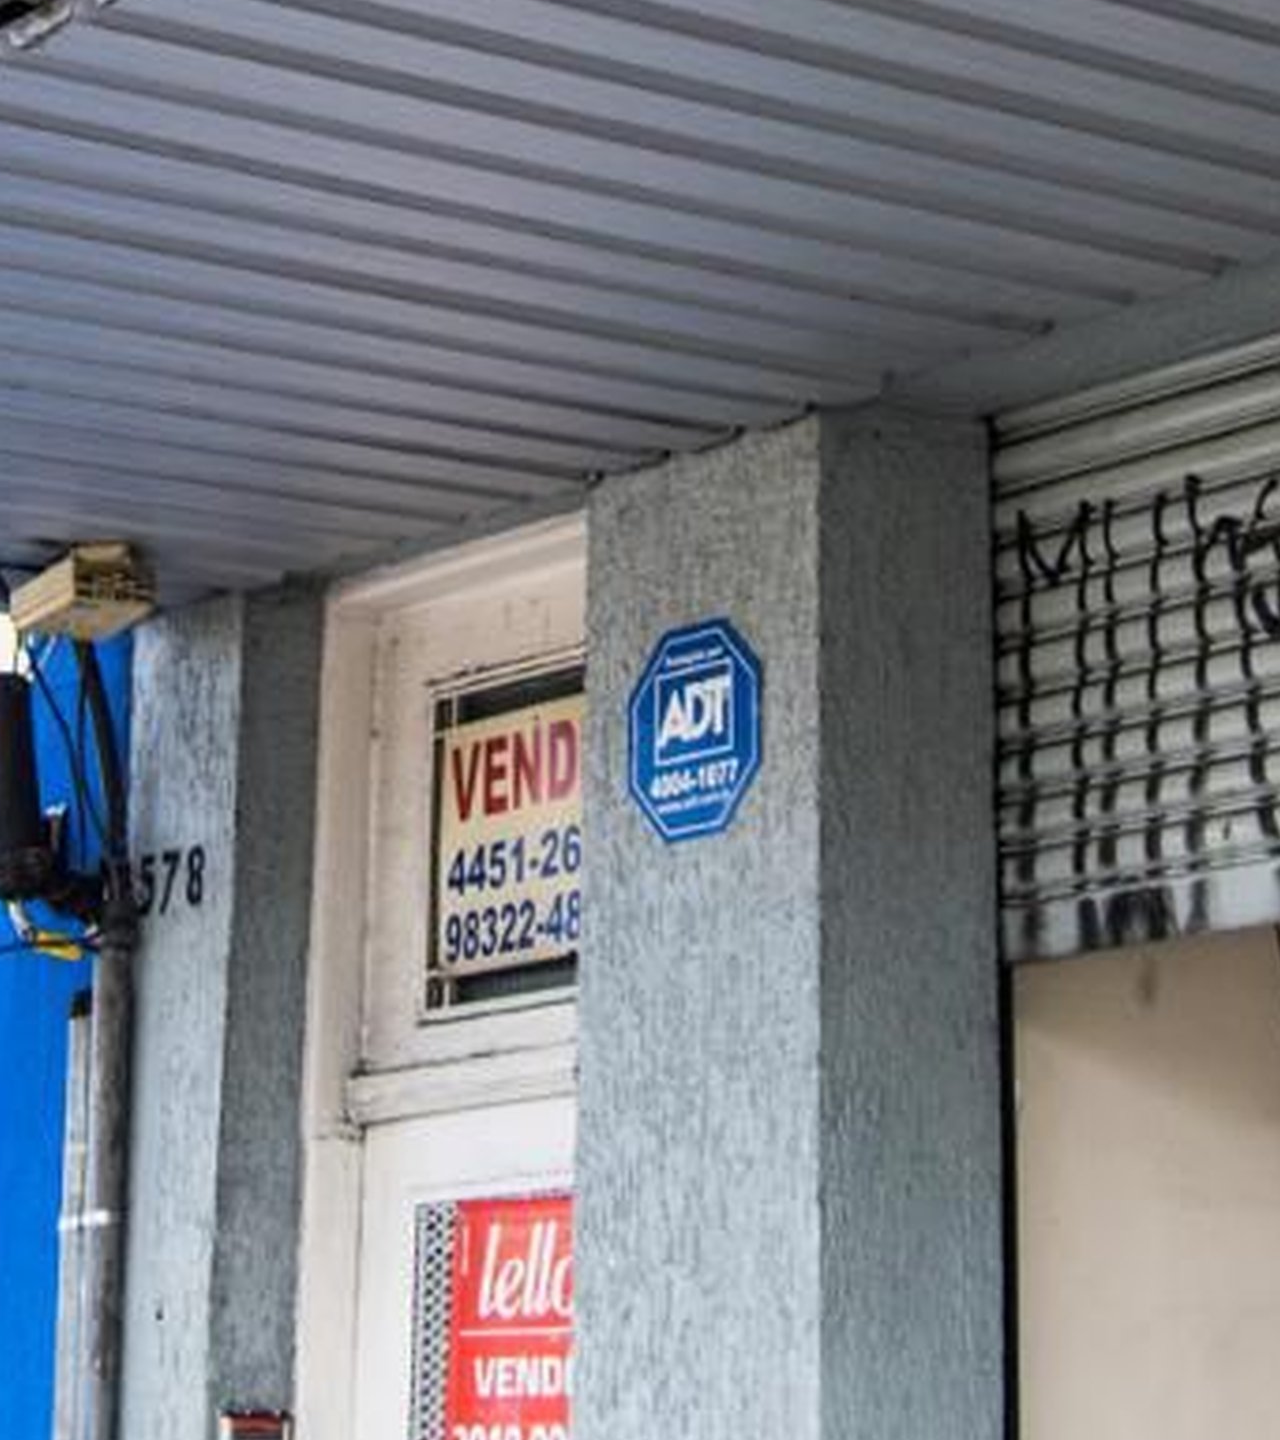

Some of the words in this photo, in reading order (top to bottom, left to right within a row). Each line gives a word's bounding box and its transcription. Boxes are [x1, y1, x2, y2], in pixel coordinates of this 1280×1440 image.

[656, 673, 732, 749] ADT
[138, 842, 206, 917] 578
[447, 825, 582, 896] 4451-26
[474, 1356, 573, 1398] VEND
